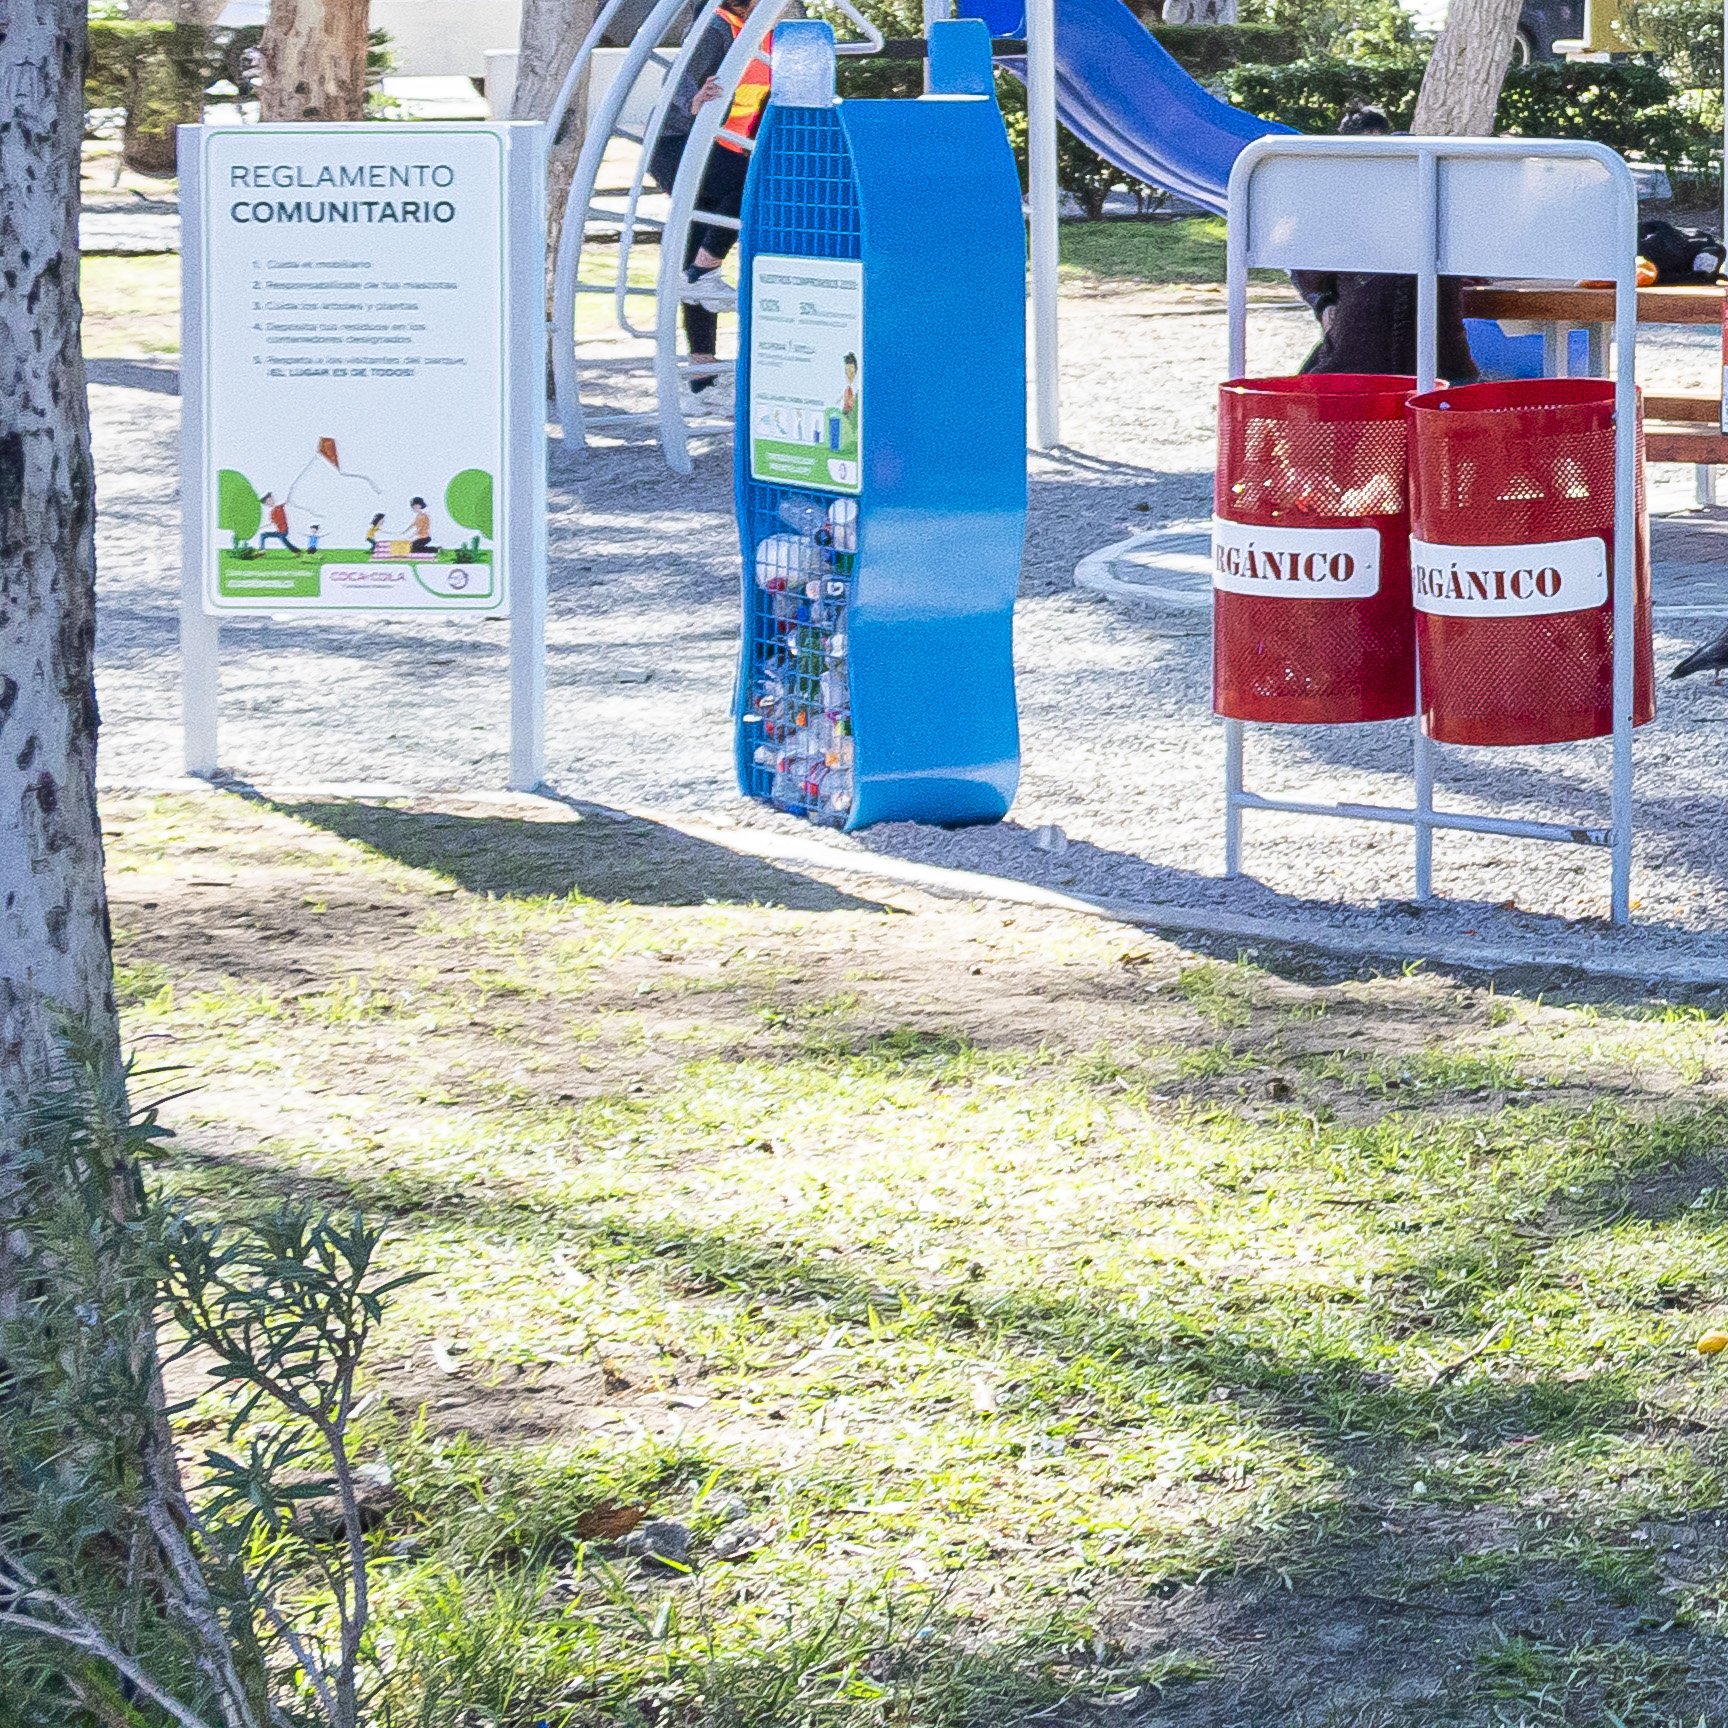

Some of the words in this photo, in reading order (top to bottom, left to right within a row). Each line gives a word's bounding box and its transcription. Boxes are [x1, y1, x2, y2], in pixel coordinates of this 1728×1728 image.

[230, 164, 455, 188] REGLAMENTO
[230, 200, 456, 223] COMUNITARIO
[1216, 542, 1355, 582] RGÁNICO
